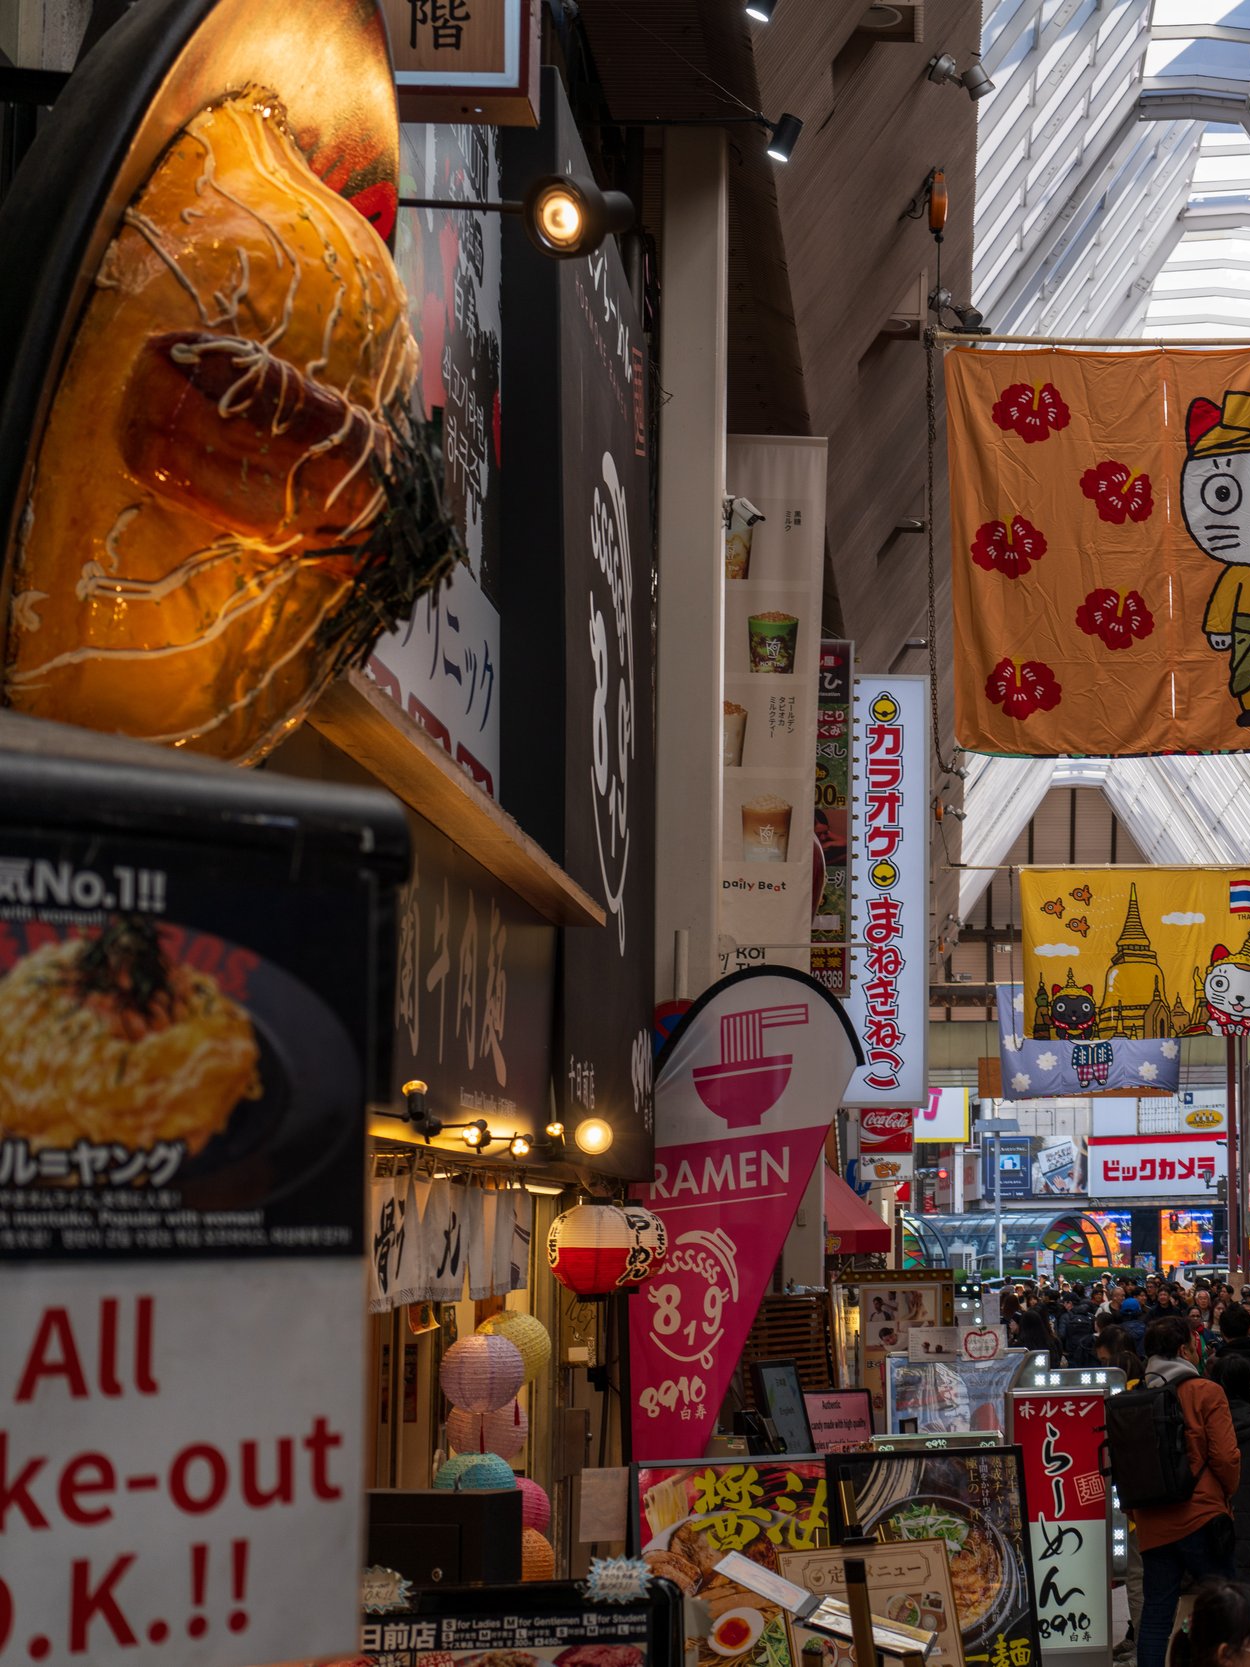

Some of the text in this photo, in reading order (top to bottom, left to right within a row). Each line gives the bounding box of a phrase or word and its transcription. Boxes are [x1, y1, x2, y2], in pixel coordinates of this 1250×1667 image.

[778, 695, 786, 727] タピオカ
[787, 695, 795, 735] ゴールデン
[722, 878, 787, 893] Daily Beat
[863, 723, 906, 1091] カラオケ まねきねこ
[863, 1111, 910, 1129] Coca-Cola
[652, 1146, 791, 1200] RAMEN
[1103, 1156, 1216, 1182] ビックカメラ
[165, 1210, 199, 1227] with
[616, 1211, 652, 1286] らーめん
[15, 1296, 158, 1403] All
[639, 1375, 707, 1418] 8910
[1018, 1400, 1099, 1419] ホルモン
[680, 1403, 707, 1421] 白寿
[1037, 1421, 1086, 1609] らーめん
[828, 1564, 922, 1585] 定メニュー
[443, 1613, 647, 1631] S for Ladies M for Gentlemen L for Student
[1037, 1611, 1091, 1641] 8910
[1069, 1631, 1093, 1643] 白寿
